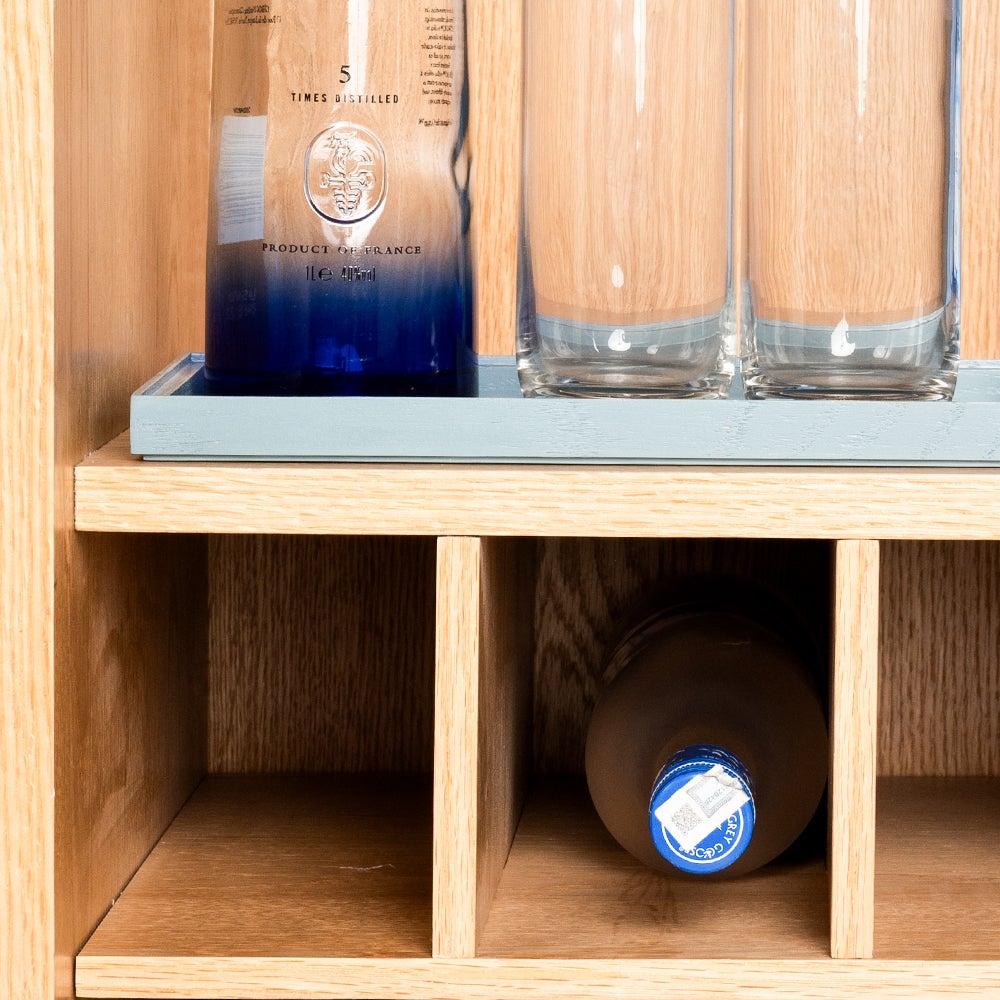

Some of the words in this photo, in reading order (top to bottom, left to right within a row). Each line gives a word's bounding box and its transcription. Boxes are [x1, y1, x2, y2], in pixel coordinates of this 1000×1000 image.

[339, 65, 351, 84] 5
[291, 93, 328, 103] TIMES
[335, 94, 399, 104] DISTILLED
[262, 243, 329, 254] PRODUCT
[338, 246, 358, 254] OF
[365, 246, 422, 255] FRANCE
[724, 814, 738, 844] GREY
